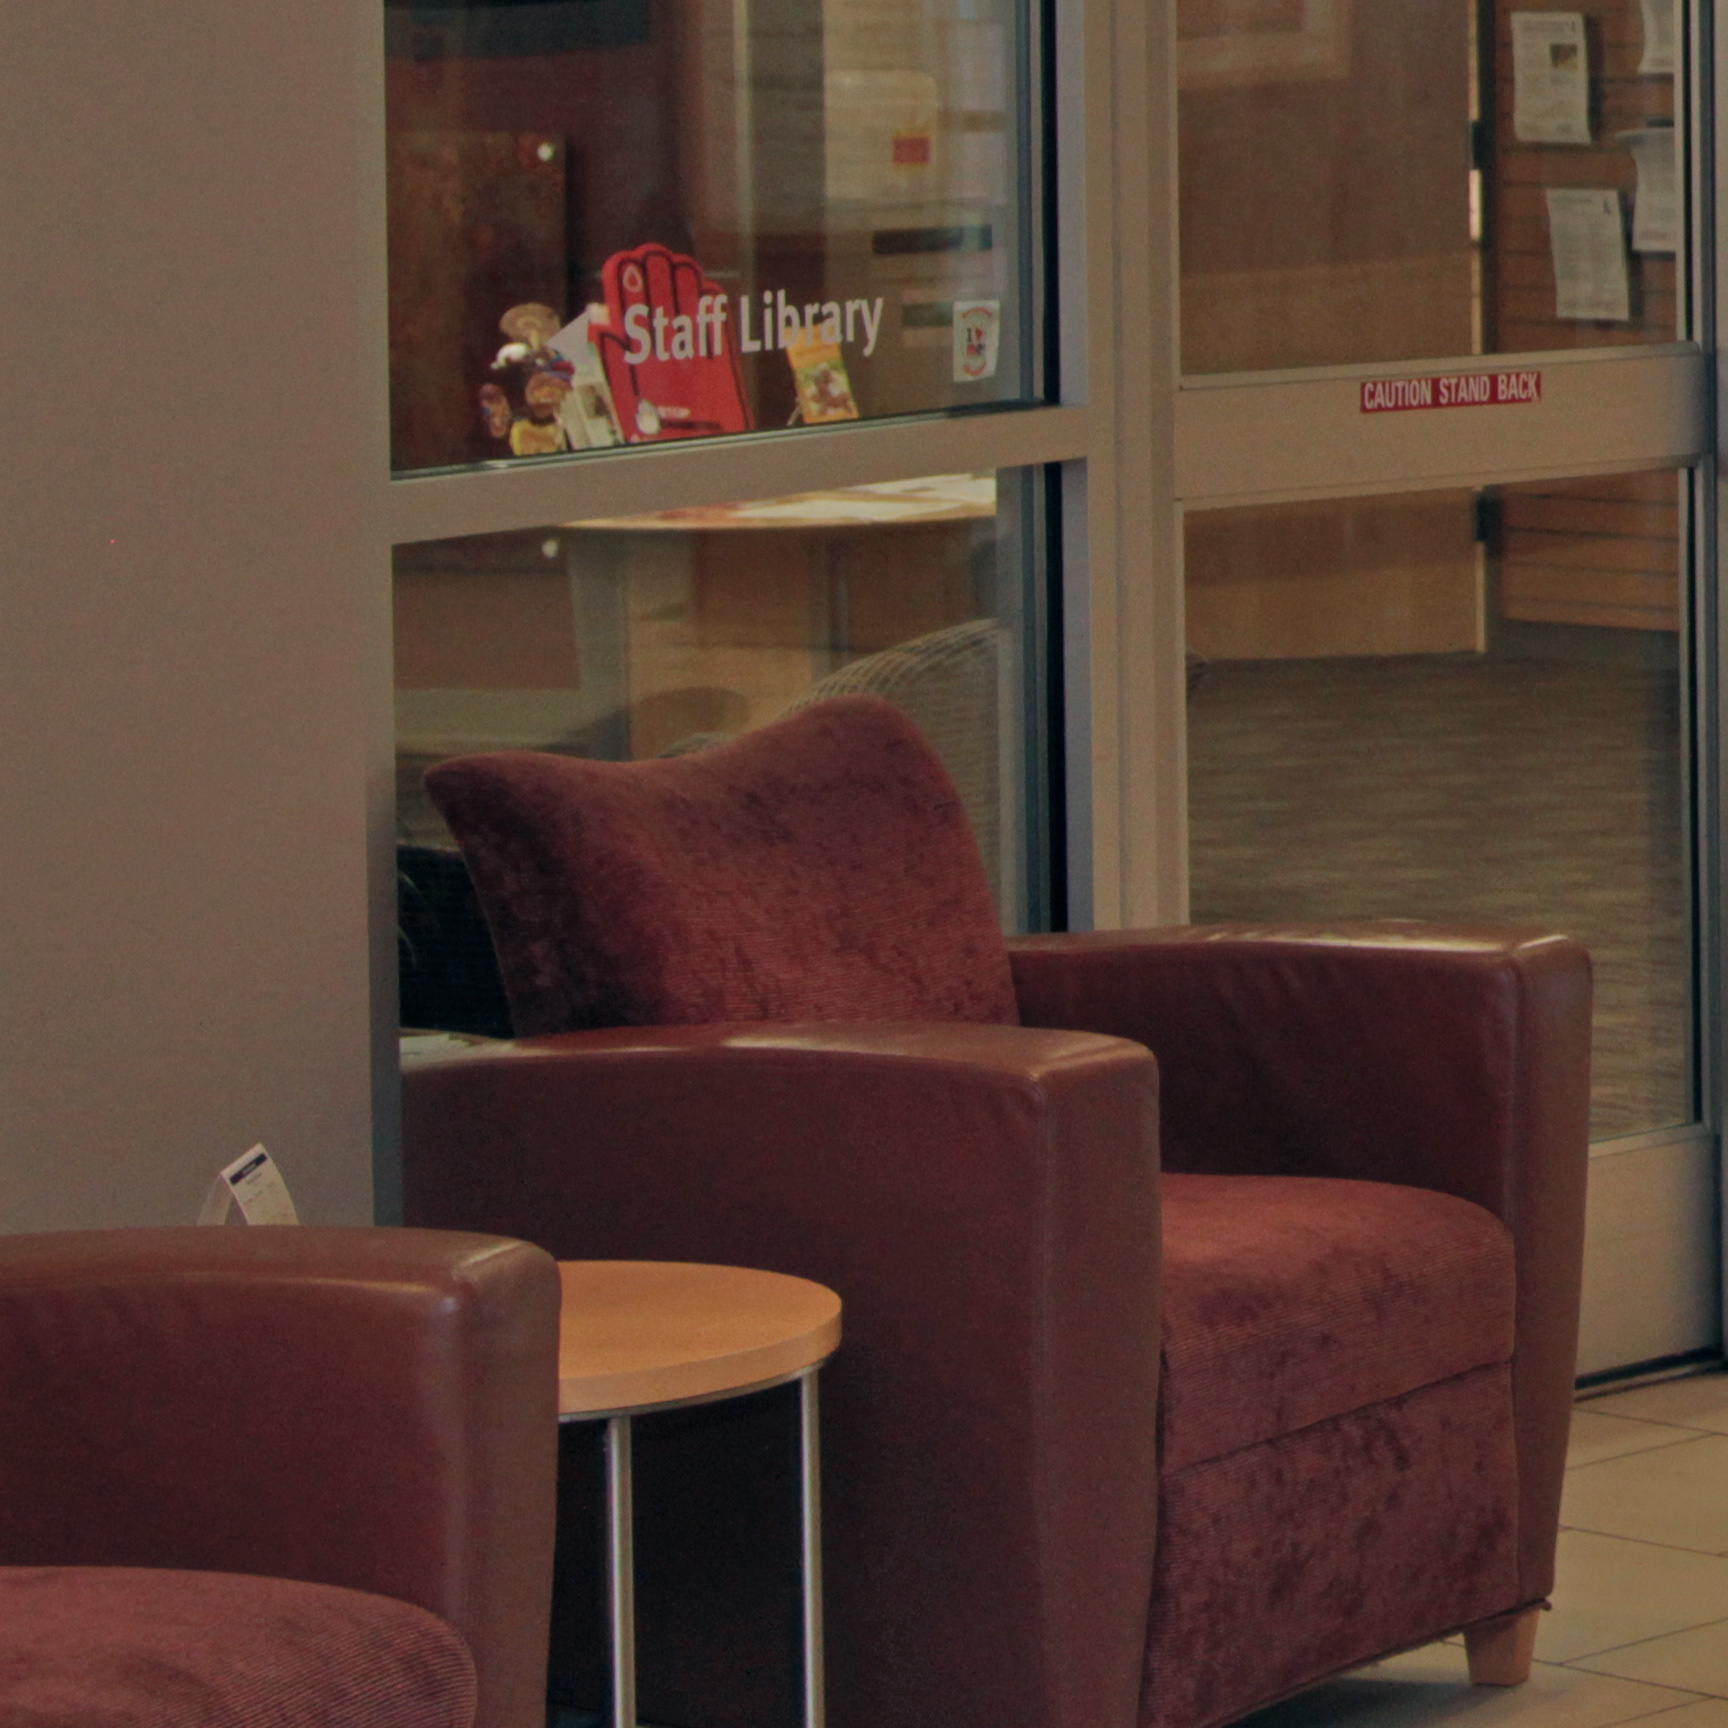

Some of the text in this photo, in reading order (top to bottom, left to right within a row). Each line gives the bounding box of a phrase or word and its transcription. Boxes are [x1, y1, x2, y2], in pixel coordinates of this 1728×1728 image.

[624, 288, 884, 365] Staff Library
[1363, 372, 1540, 410] CAUTION STAND BACK
